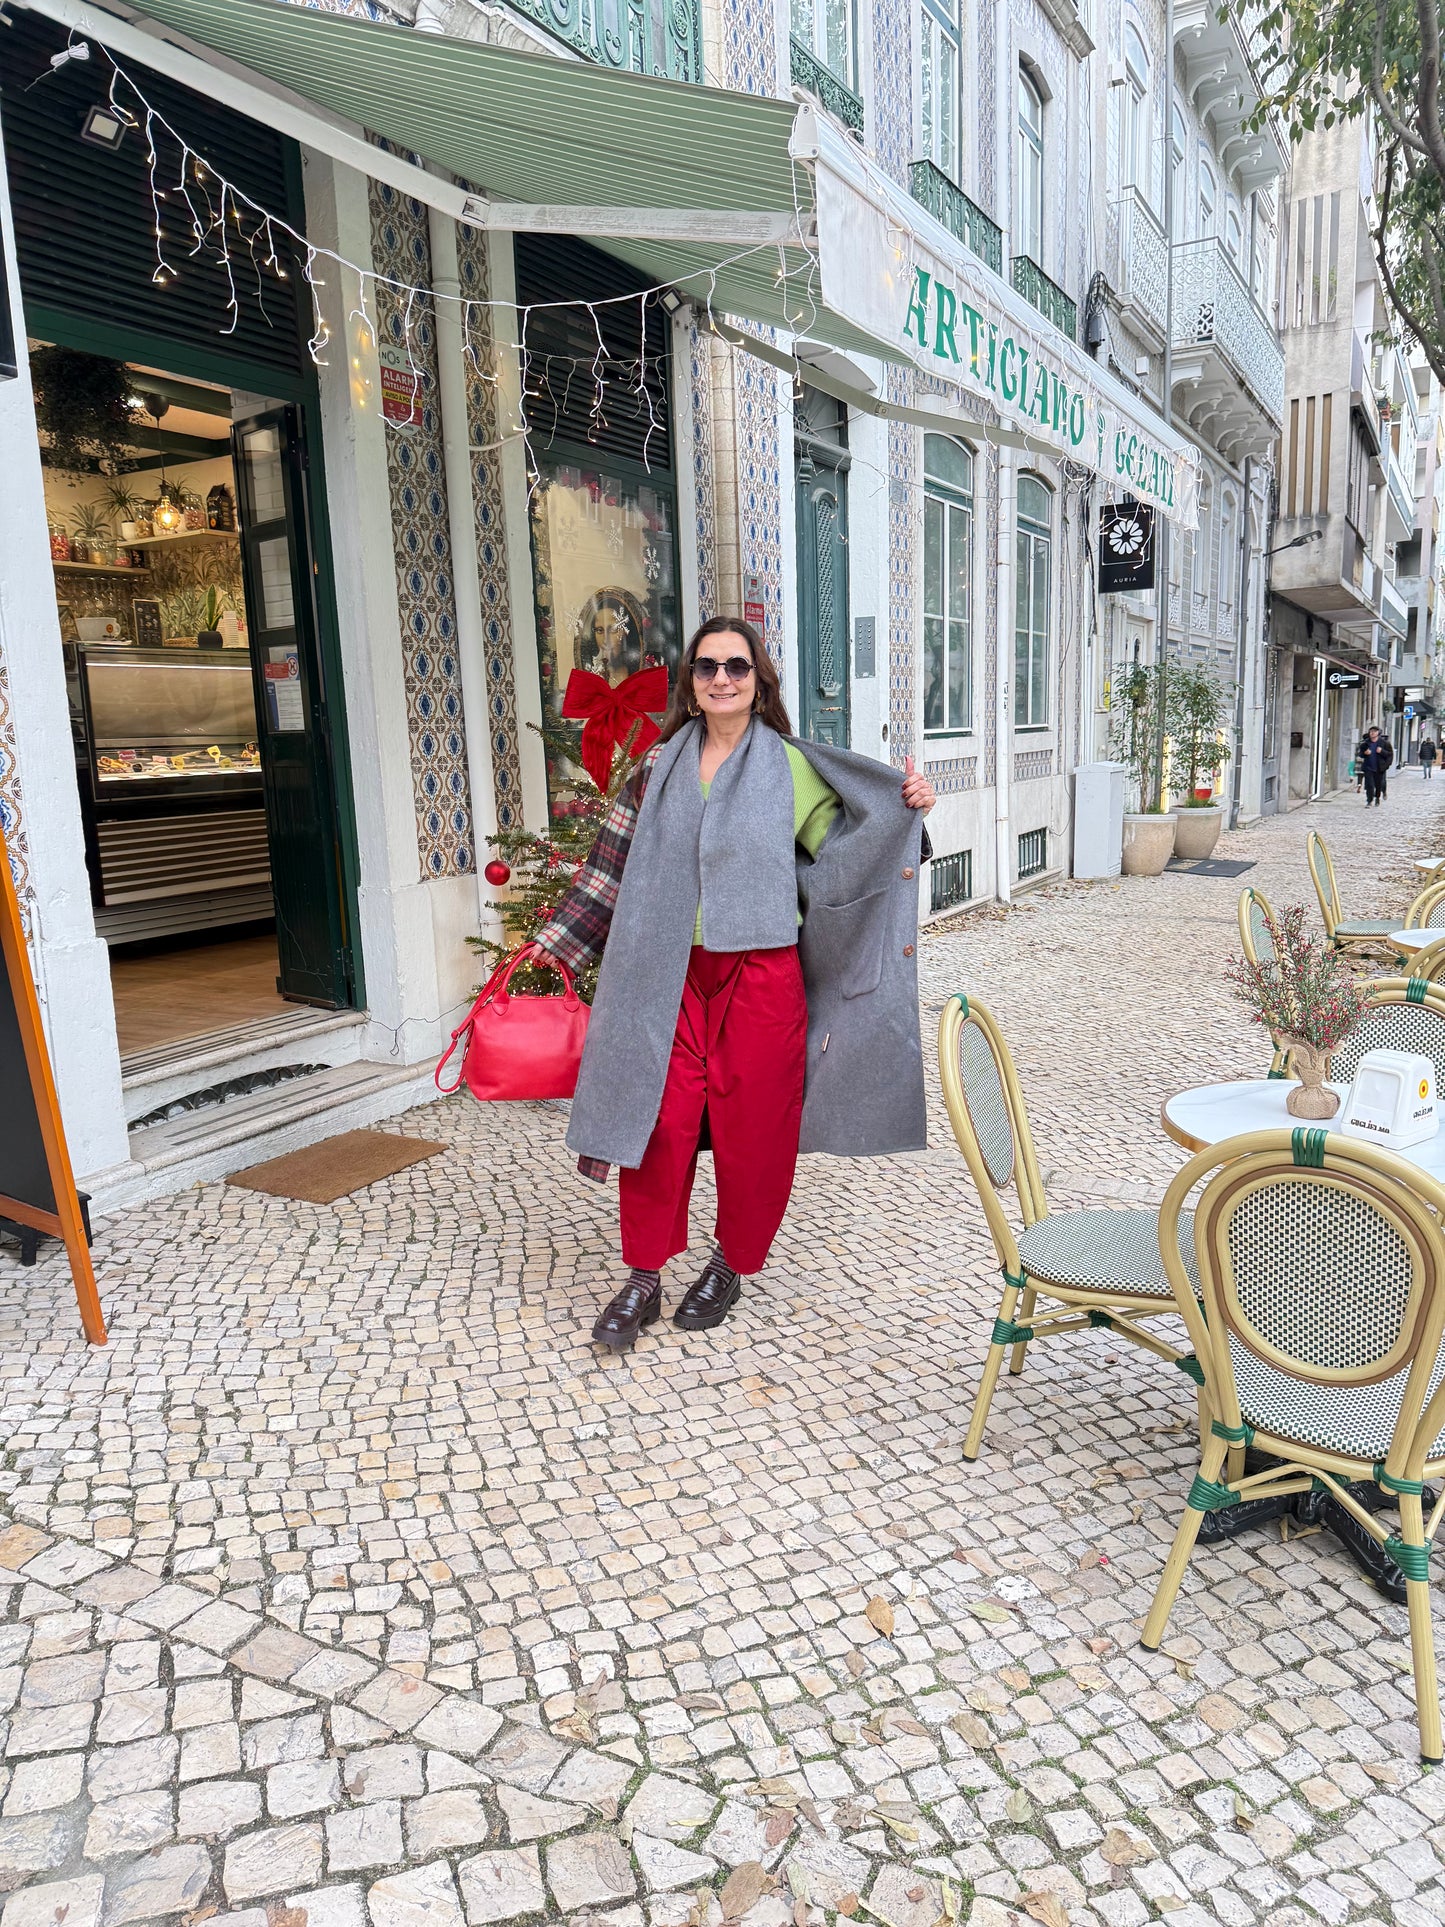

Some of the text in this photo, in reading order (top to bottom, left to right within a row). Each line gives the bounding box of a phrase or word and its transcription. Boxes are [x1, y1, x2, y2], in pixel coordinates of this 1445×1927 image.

[381, 350, 400, 365] NOS
[383, 369, 420, 389] ALARM
[903, 266, 1174, 508] ARTIGIANO GELATI
[383, 380, 420, 397] INTELIGENE
[1113, 576, 1137, 584] AURIA
